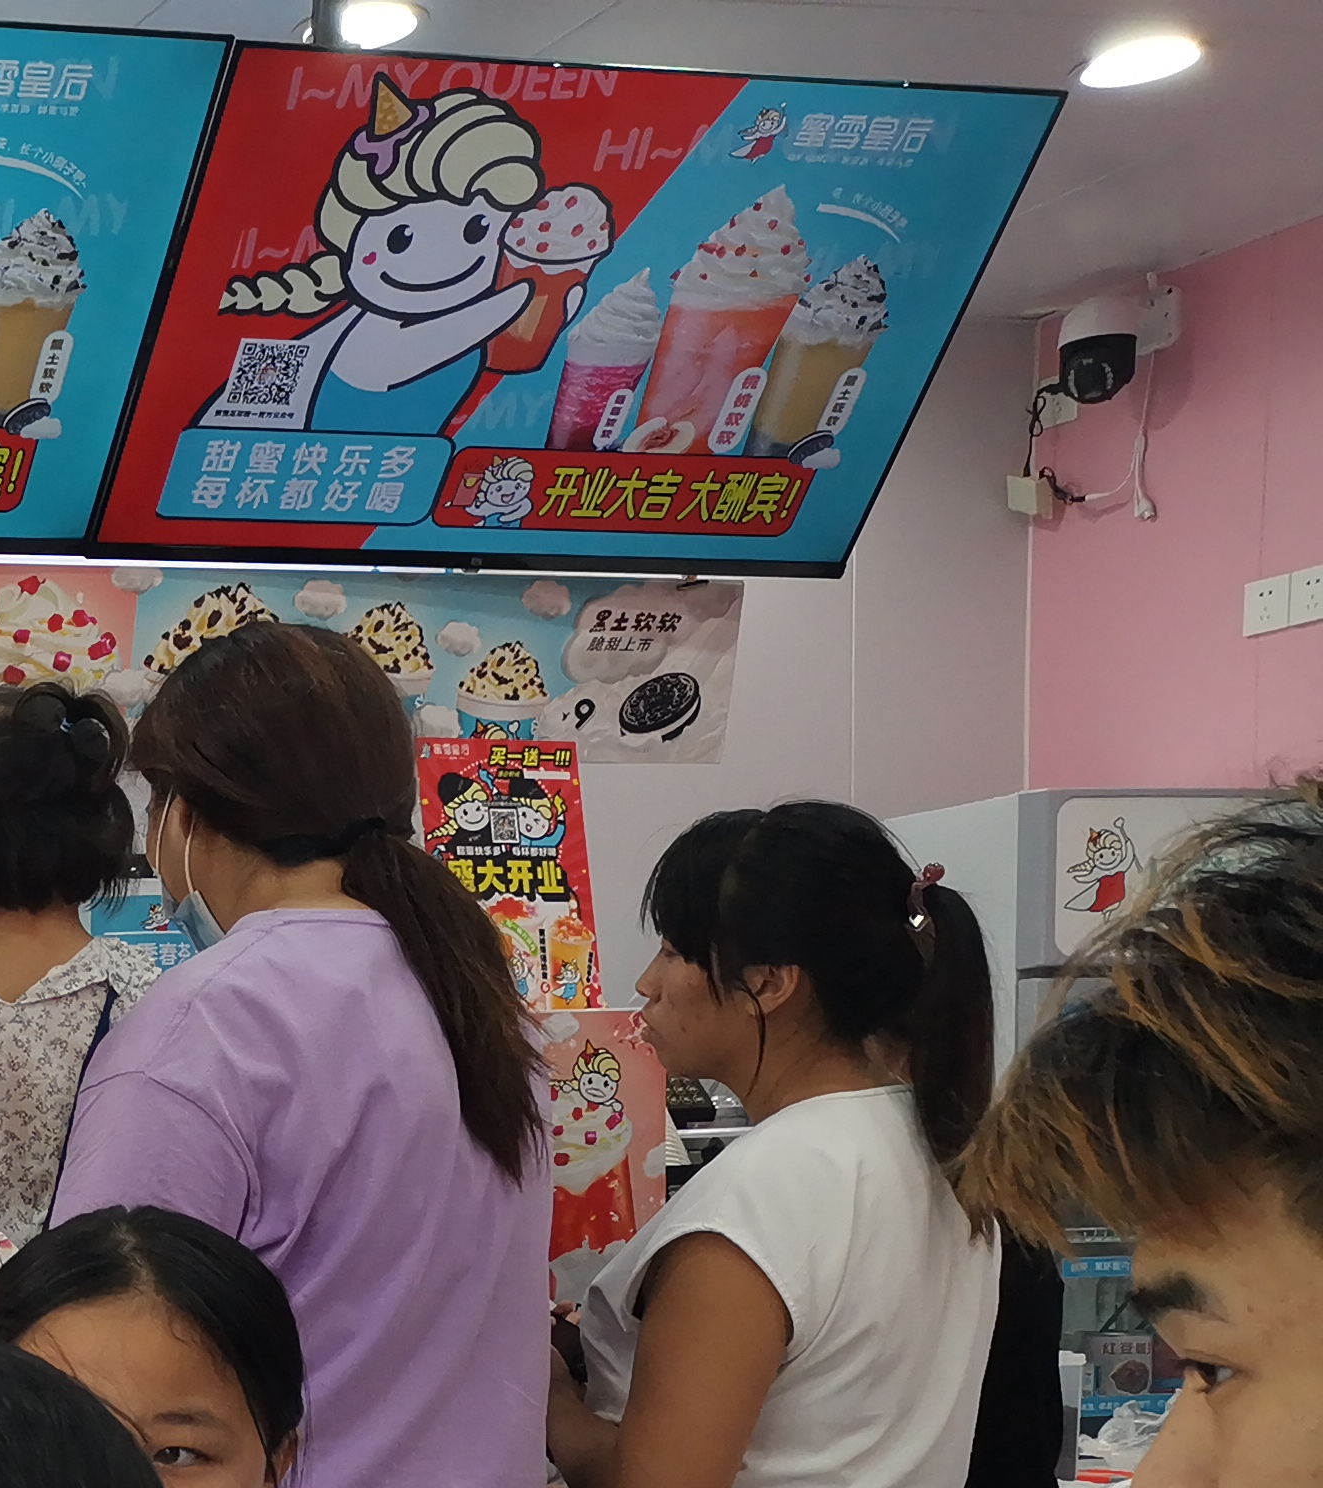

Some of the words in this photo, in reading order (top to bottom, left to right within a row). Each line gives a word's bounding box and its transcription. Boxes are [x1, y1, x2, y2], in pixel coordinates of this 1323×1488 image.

[793, 113, 935, 153] 蜜雪皇后
[201, 439, 416, 479] 甜蜜快乐多
[191, 475, 405, 514] 每杯都好喝
[539, 467, 682, 519] 开业大吉
[677, 470, 802, 524] 大酬宾!
[588, 609, 683, 634] 黑土软软
[586, 636, 655, 653] 脆甜上市
[447, 859, 566, 895] 盛大开业
